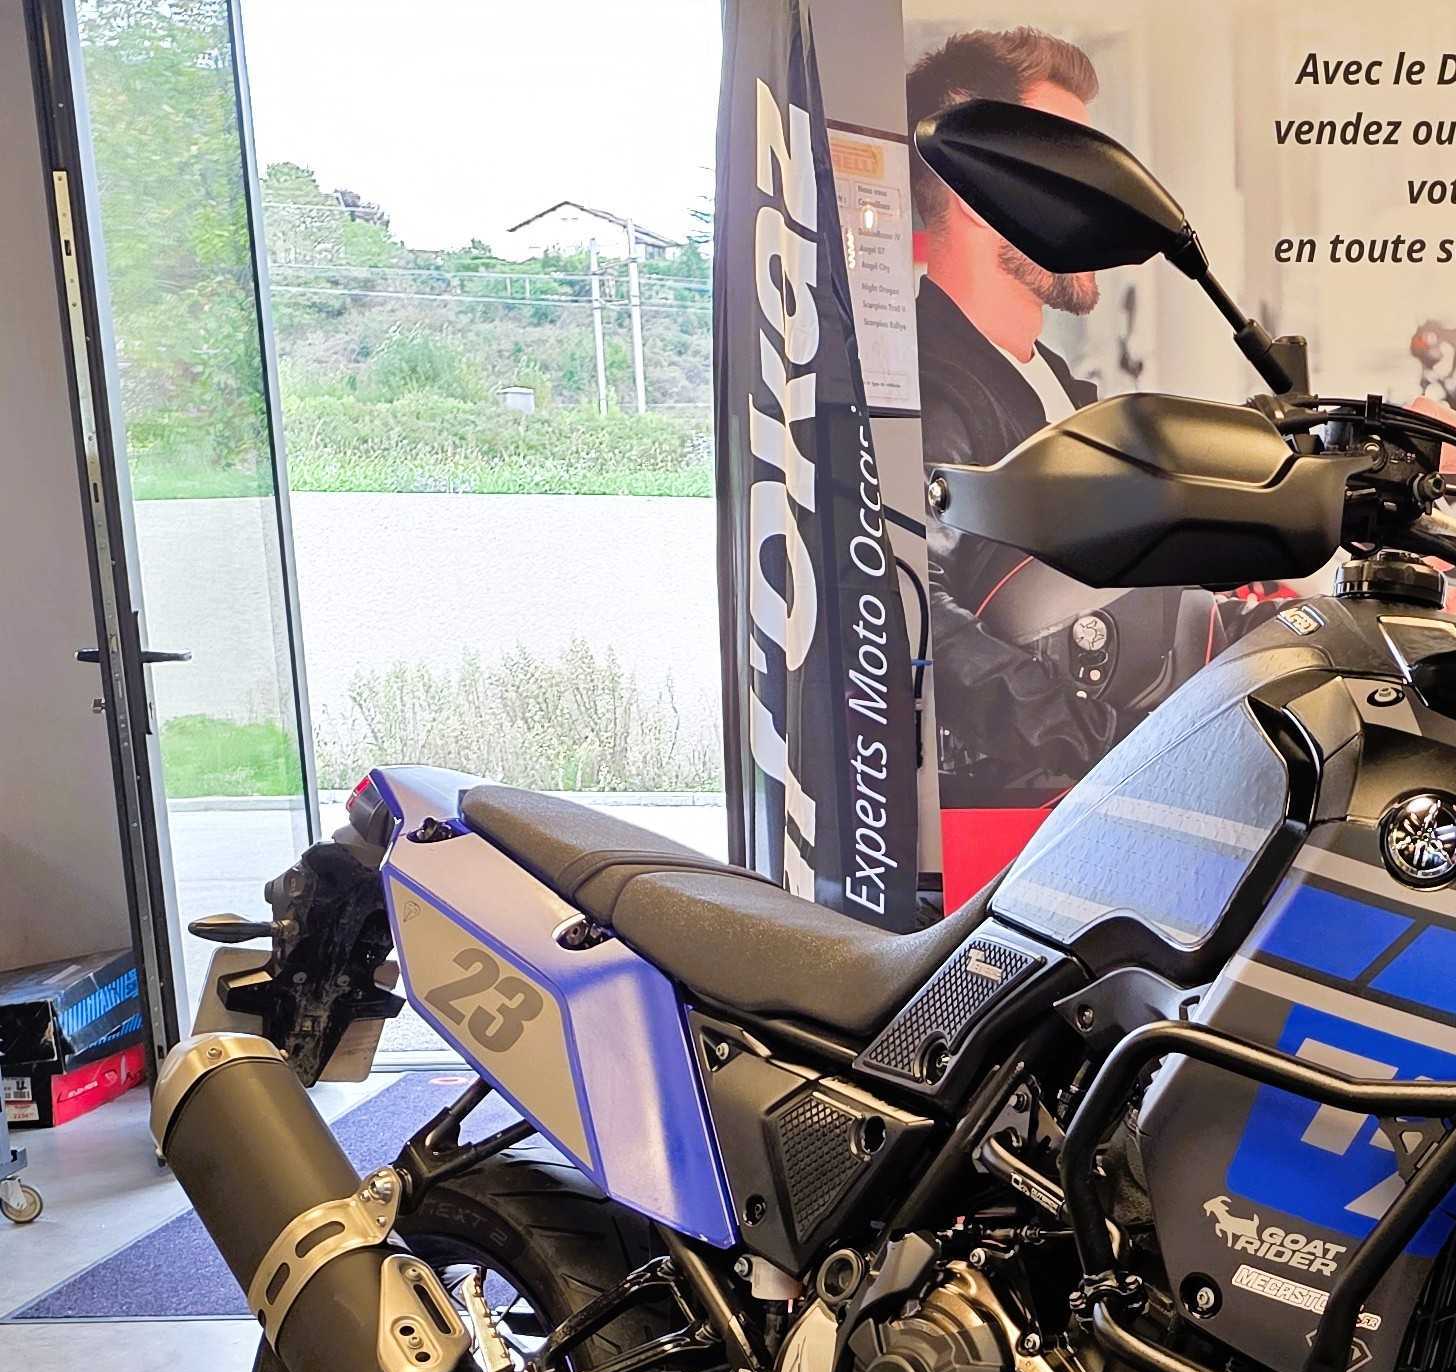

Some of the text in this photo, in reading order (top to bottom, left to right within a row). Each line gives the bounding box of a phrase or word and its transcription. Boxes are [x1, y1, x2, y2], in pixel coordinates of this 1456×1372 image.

[1295, 52, 1382, 86] Avec
[1393, 51, 1425, 86] le
[1274, 111, 1402, 146] vendez
[1412, 120, 1456, 146] ou
[1274, 236, 1317, 264] en
[1329, 233, 1427, 264] toute
[849, 594, 888, 725] Moto
[846, 735, 898, 914] Experts
[424, 948, 544, 1053] 23
[1234, 1235, 1338, 1277] RIDER
[1261, 1226, 1347, 1260] GOAT
